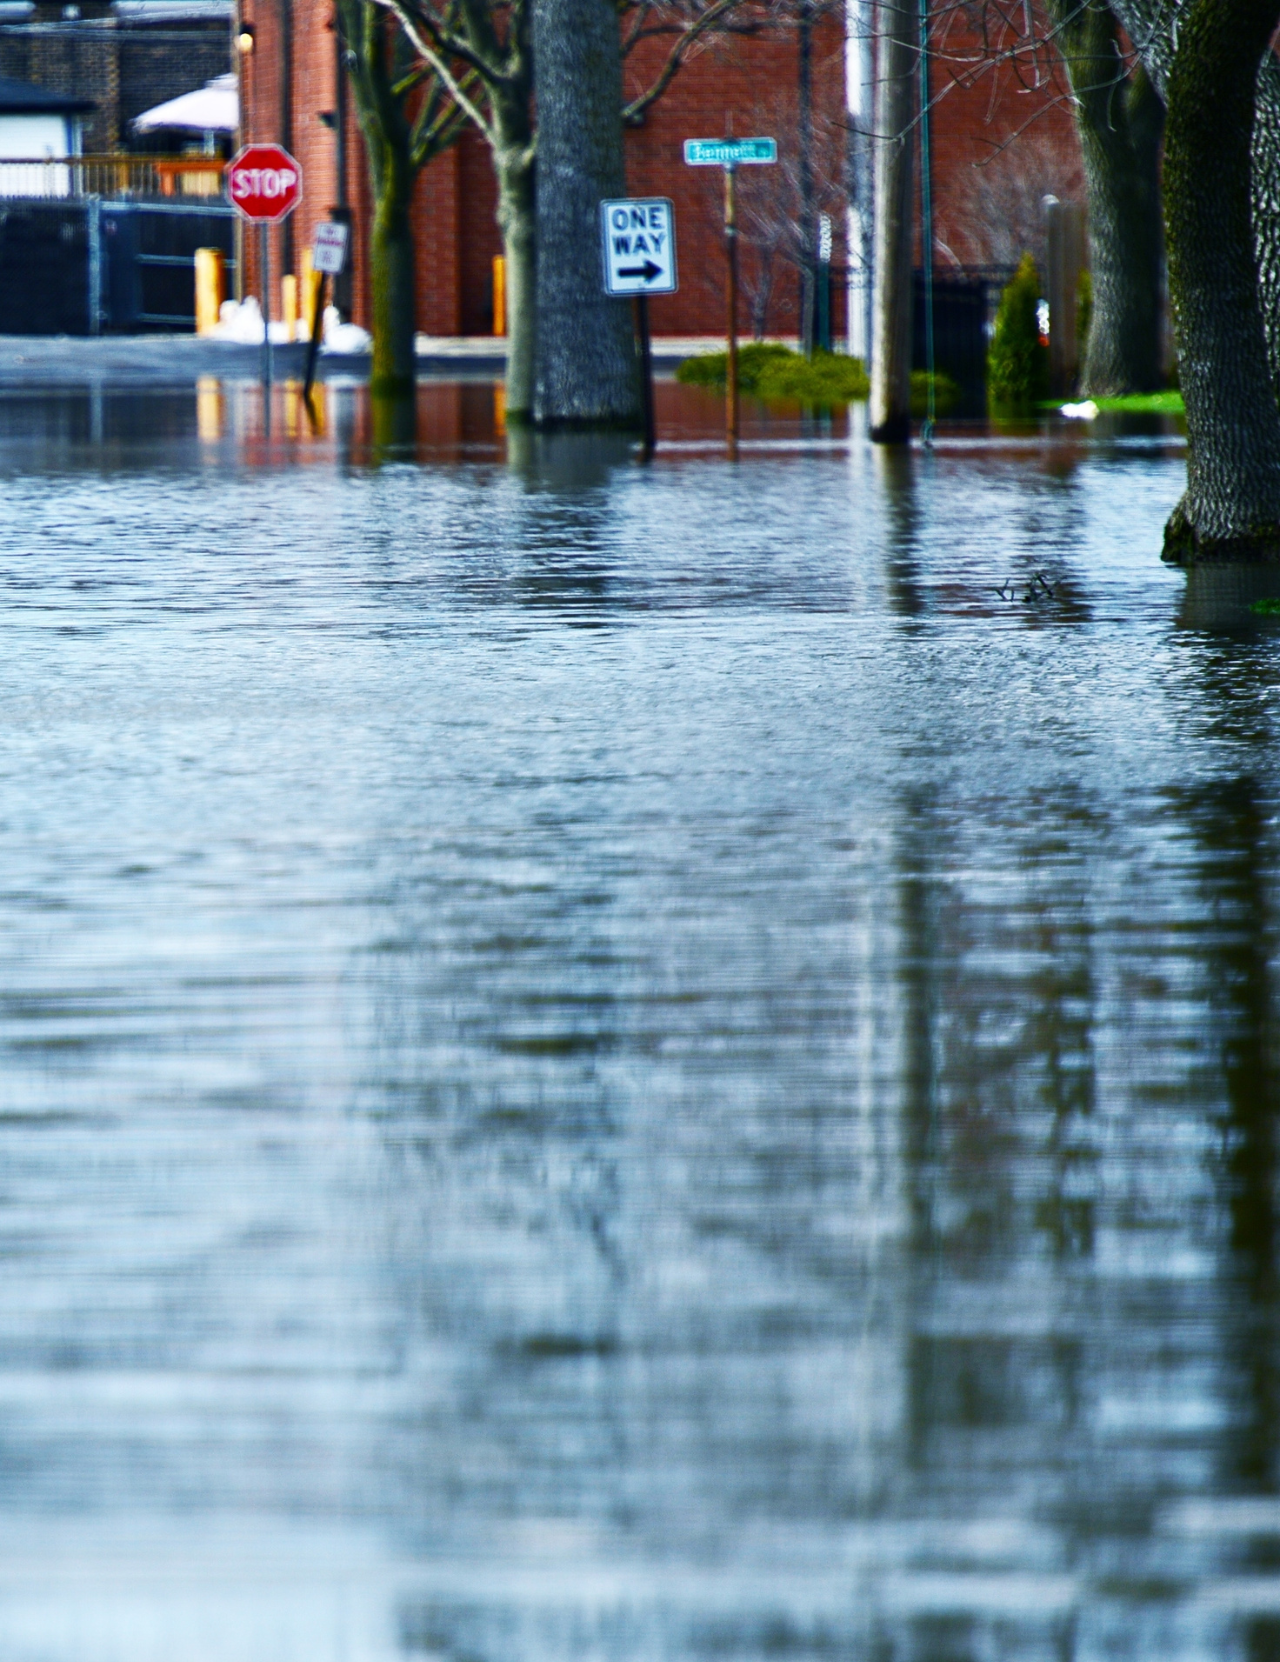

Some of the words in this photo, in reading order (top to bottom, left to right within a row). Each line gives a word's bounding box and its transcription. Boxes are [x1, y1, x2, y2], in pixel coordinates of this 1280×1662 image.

[233, 168, 297, 199] STOP
[612, 207, 664, 231] ONE
[612, 232, 666, 255] WAY
